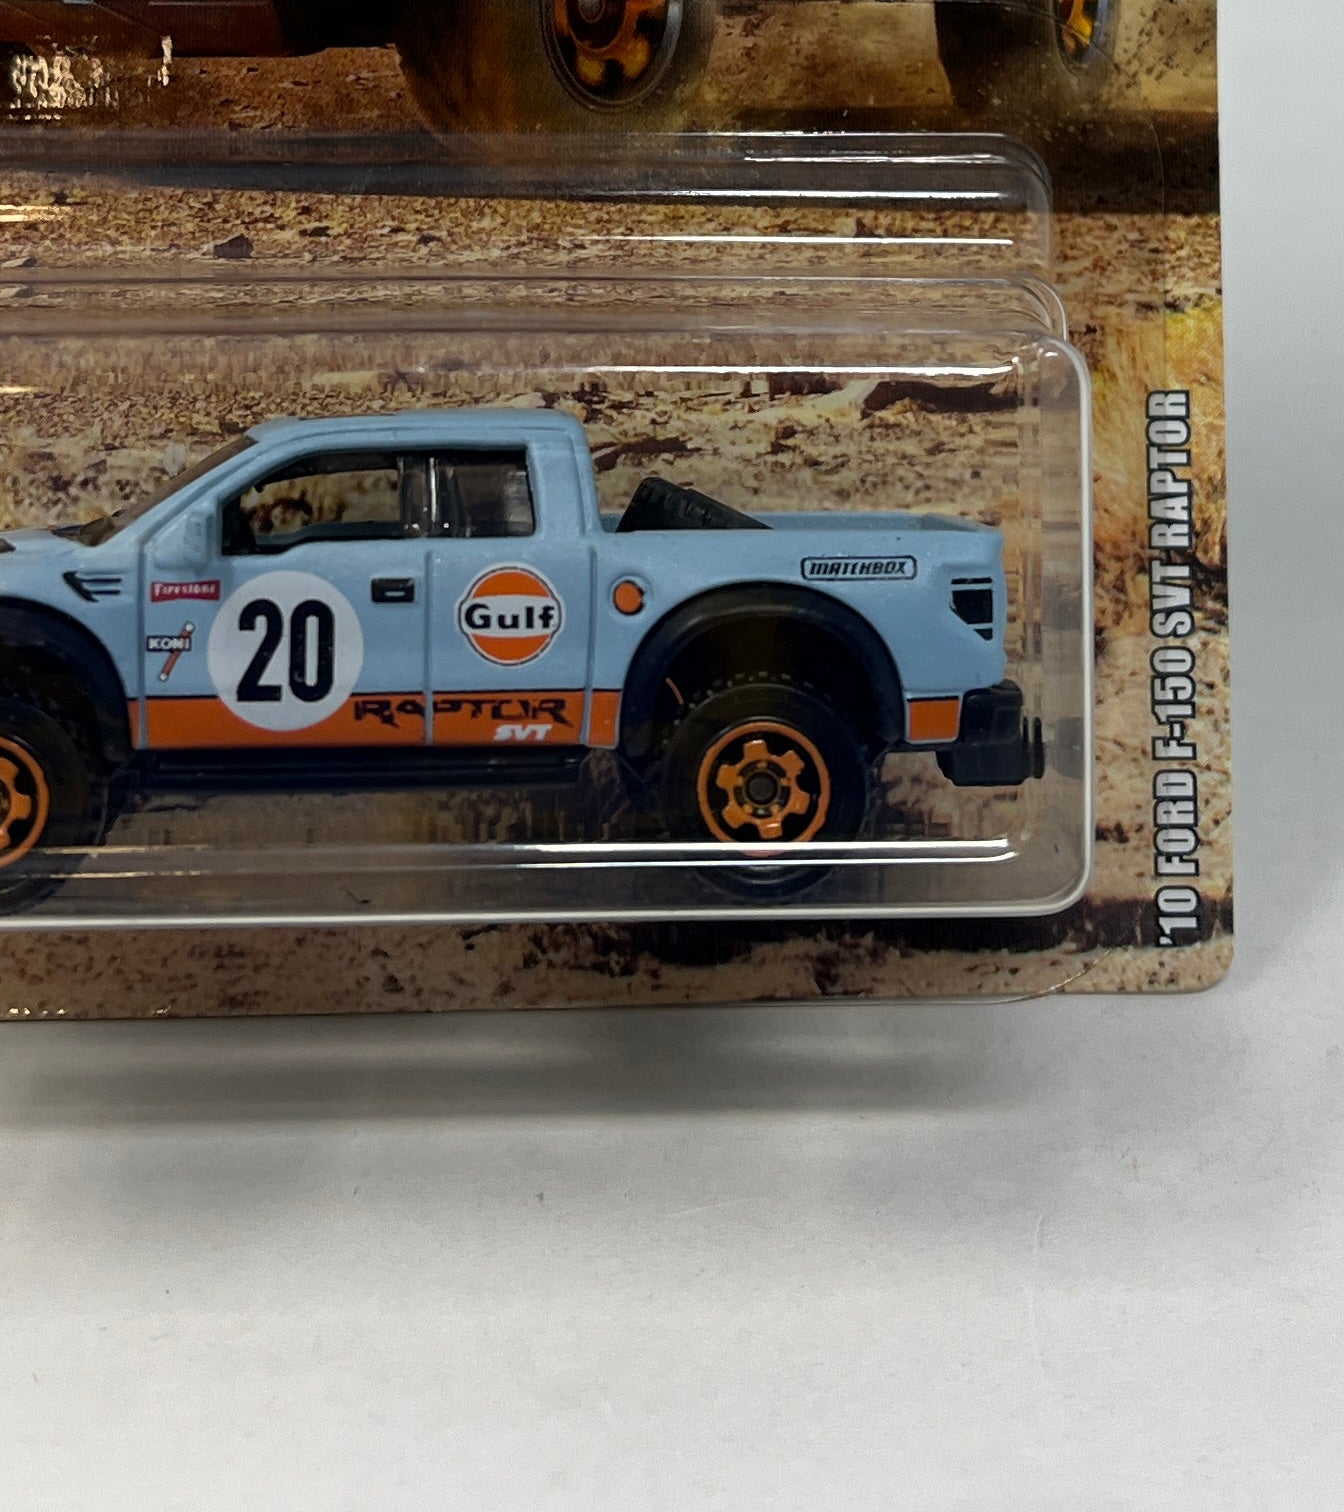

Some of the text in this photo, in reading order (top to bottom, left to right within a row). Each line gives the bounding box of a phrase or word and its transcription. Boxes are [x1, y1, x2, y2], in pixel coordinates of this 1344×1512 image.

[1146, 389, 1194, 553] RAPTOR
[809, 561, 907, 575] MATCHBOX
[464, 601, 555, 631] Gulf
[1150, 559, 1196, 637] SVT
[148, 637, 190, 650] KONI
[236, 598, 336, 702] 20
[353, 698, 575, 729] RAPTOR
[1152, 646, 1198, 761] F-150
[493, 724, 553, 742] SVT
[1155, 768, 1200, 876] FORD
